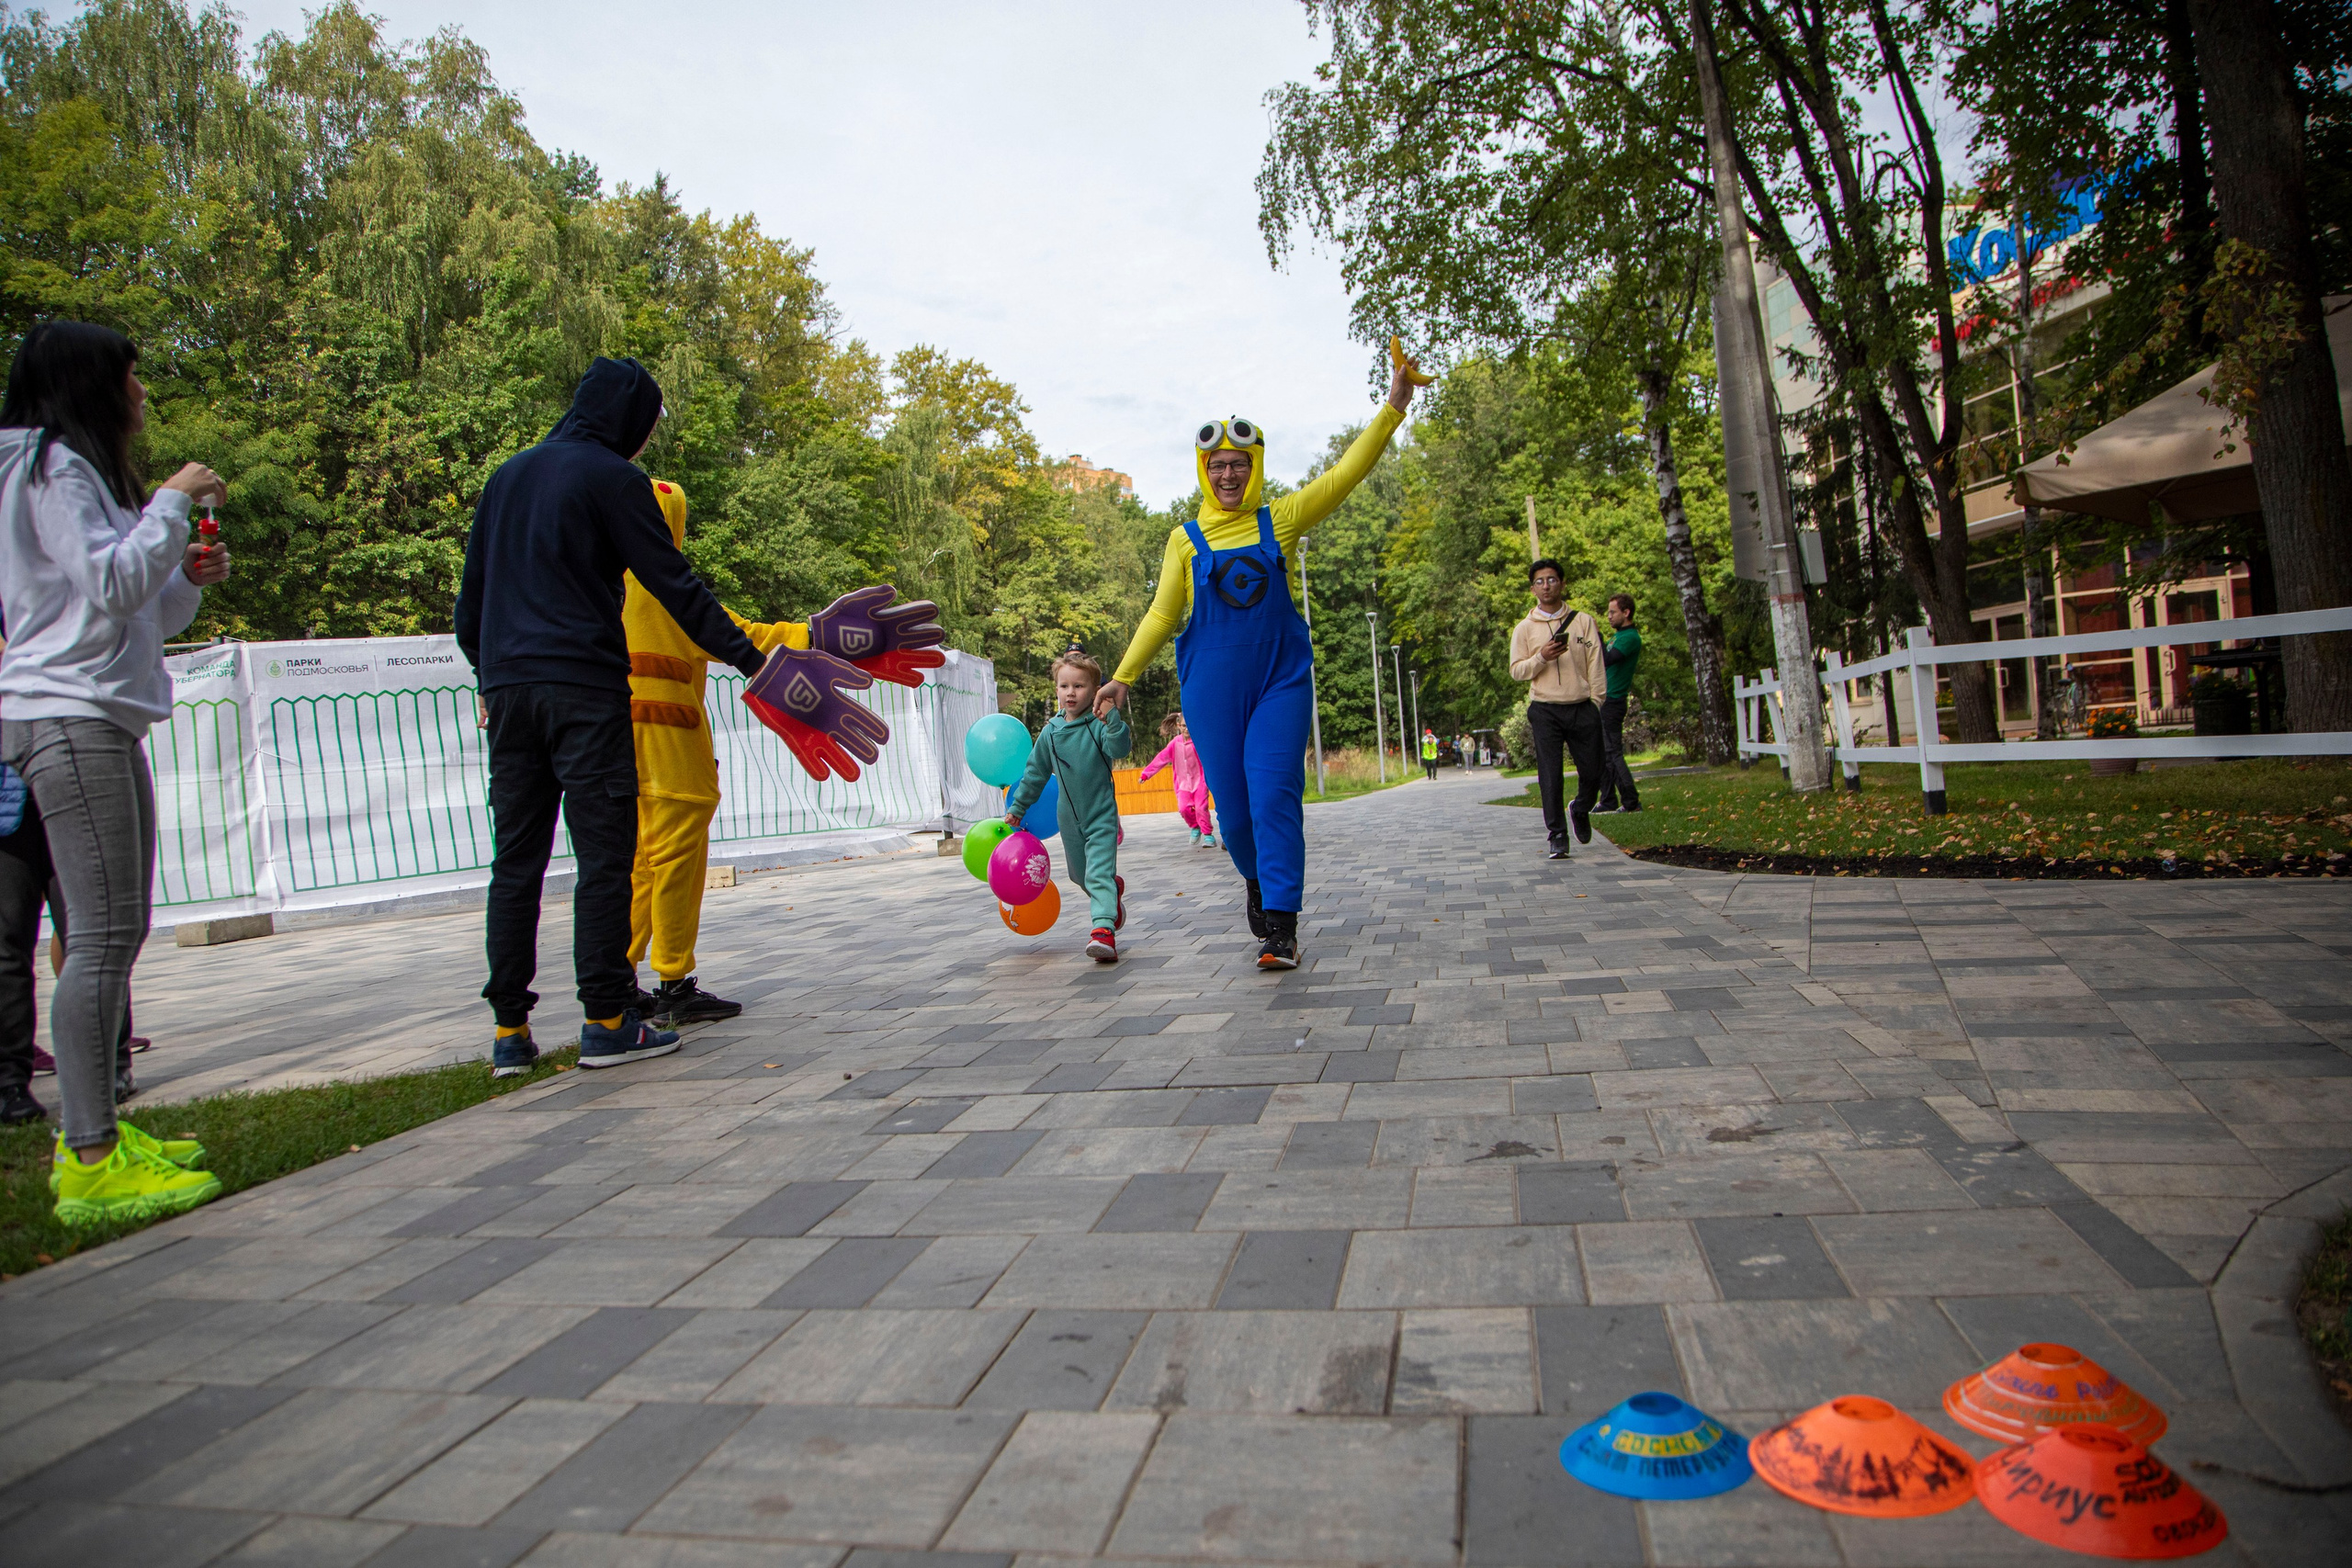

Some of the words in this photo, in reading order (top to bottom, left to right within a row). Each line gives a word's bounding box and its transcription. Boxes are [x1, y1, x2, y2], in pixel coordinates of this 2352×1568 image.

[286, 658, 322, 668] ПАРКИ
[386, 654, 454, 667] ЛЕСОПАРКИ
[187, 660, 236, 676] КОМАНДА
[287, 663, 369, 677] ПОДМОСКОВЬЯ
[172, 669, 236, 684] УБЕРНАТОРА
